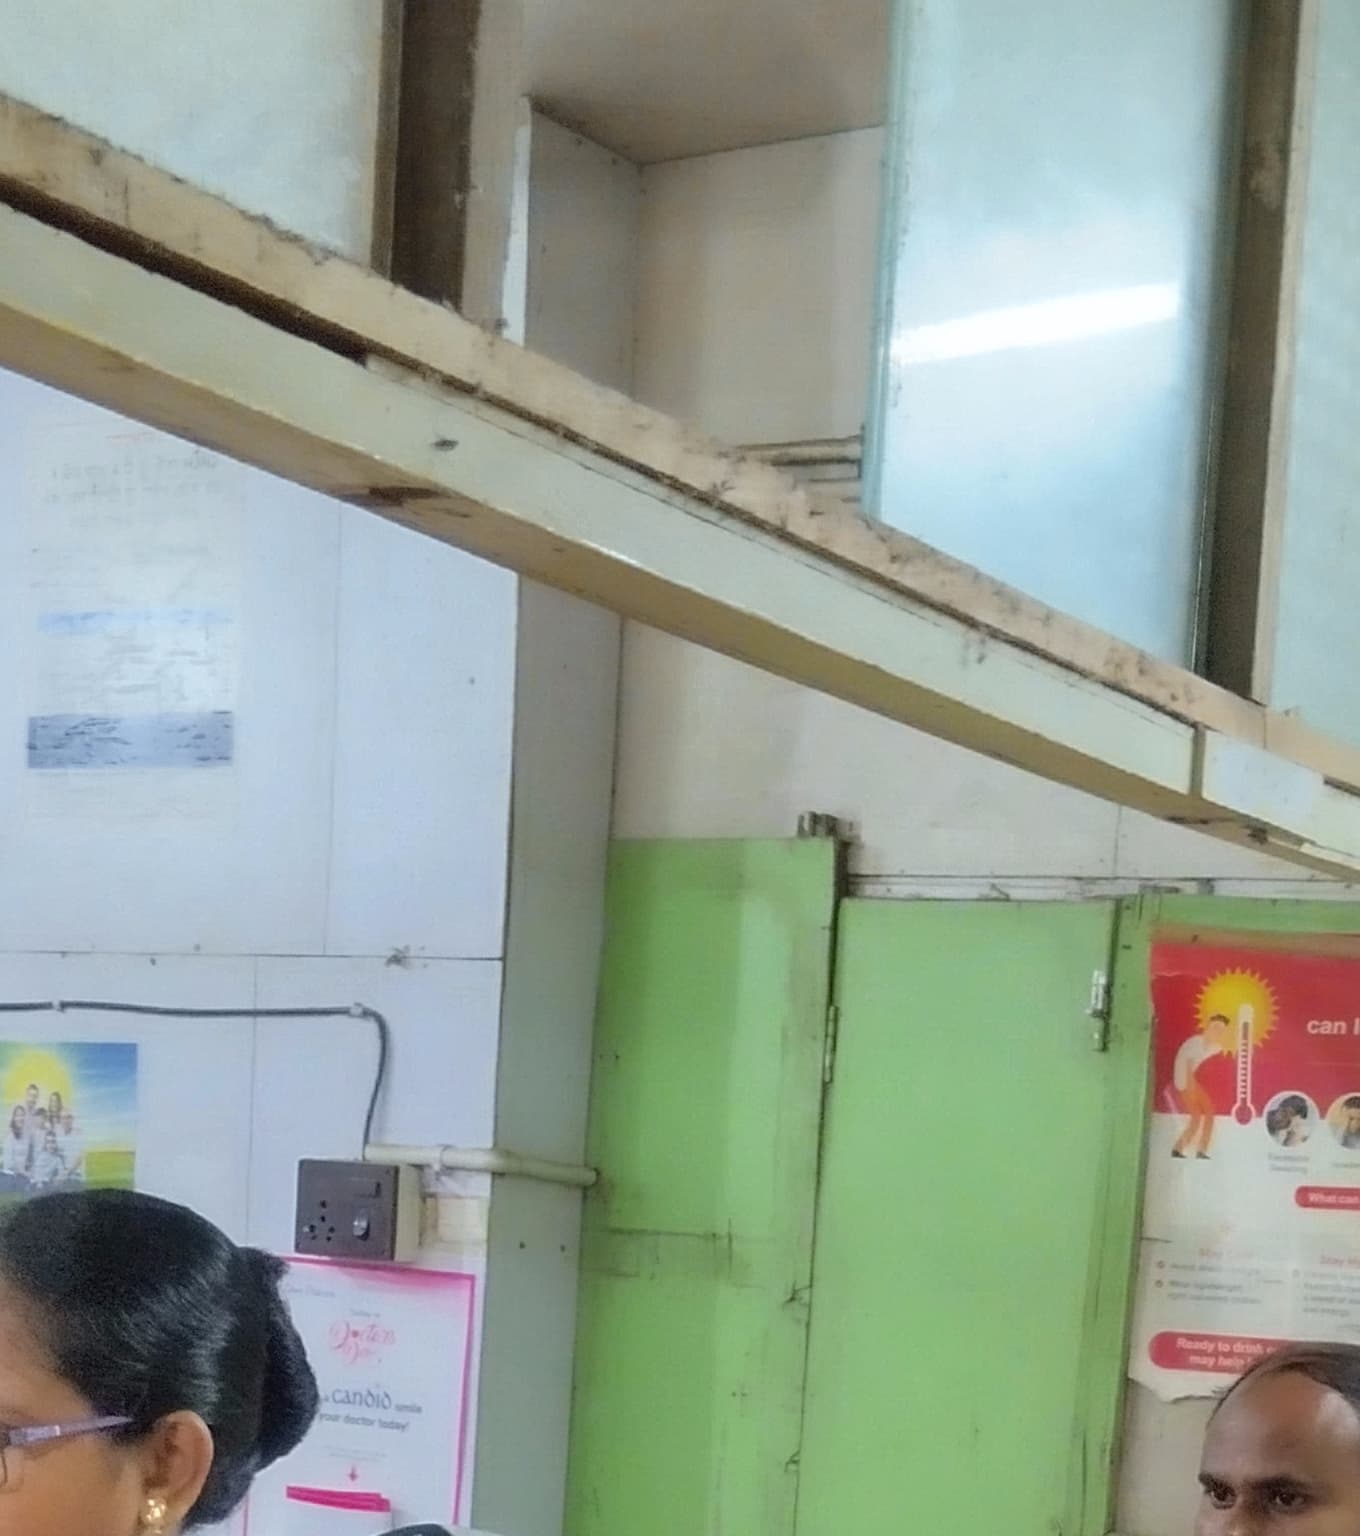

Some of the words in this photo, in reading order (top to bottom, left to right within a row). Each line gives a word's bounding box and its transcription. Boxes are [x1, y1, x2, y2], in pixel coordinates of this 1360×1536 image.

[1306, 1019, 1348, 1036] can
[1308, 1191, 1337, 1205] What
[1176, 1336, 1216, 1354] Ready
[1217, 1339, 1230, 1353] to
[1189, 1355, 1215, 1370] may
